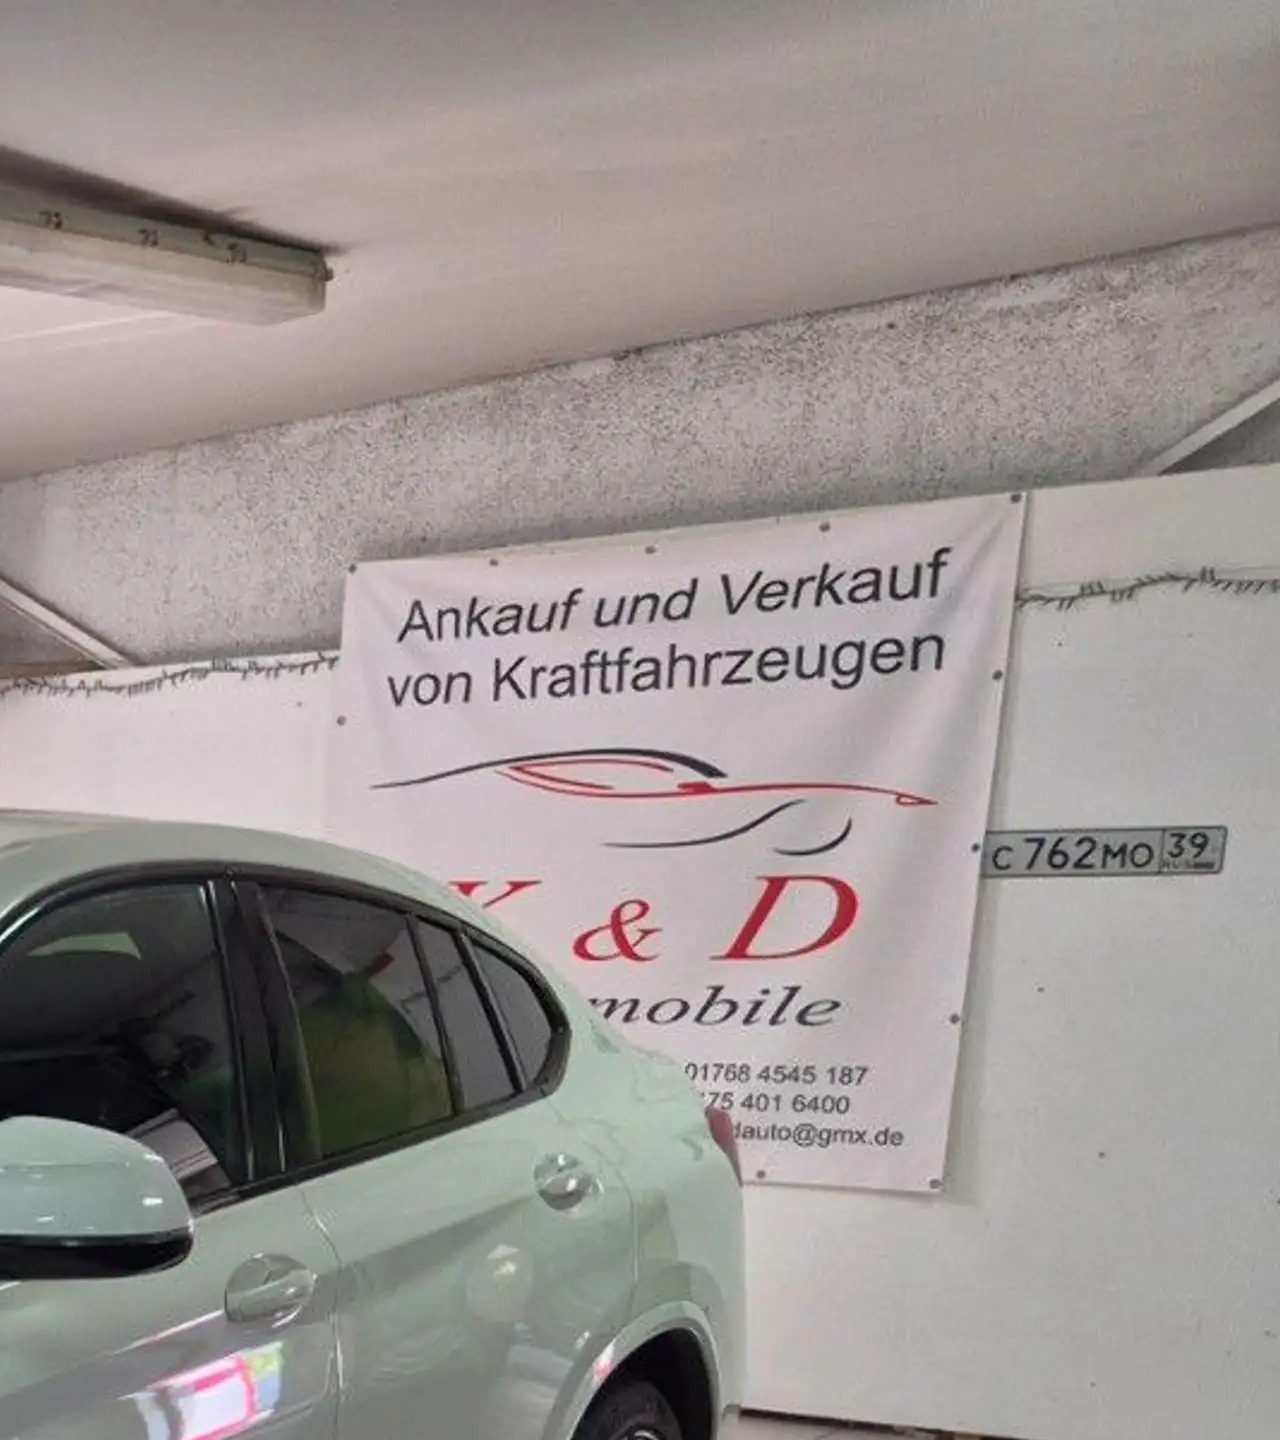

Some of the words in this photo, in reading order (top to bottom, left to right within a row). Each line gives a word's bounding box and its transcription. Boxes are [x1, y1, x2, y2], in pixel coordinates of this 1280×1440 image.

[397, 588, 583, 642] Ankauf
[593, 579, 698, 628] und
[721, 547, 952, 616] Verkauf
[387, 670, 472, 707] von
[492, 633, 945, 702] Kraftfahrzeugen
[1168, 832, 1210, 859] 39
[571, 898, 665, 962] &
[709, 874, 860, 962] D
[684, 1062, 751, 1083] 01768
[756, 1065, 817, 1085] 4545
[826, 1066, 869, 1086] 187
[701, 1091, 734, 1111] 75
[740, 1092, 782, 1112] 401
[791, 1094, 851, 1115] 6400
